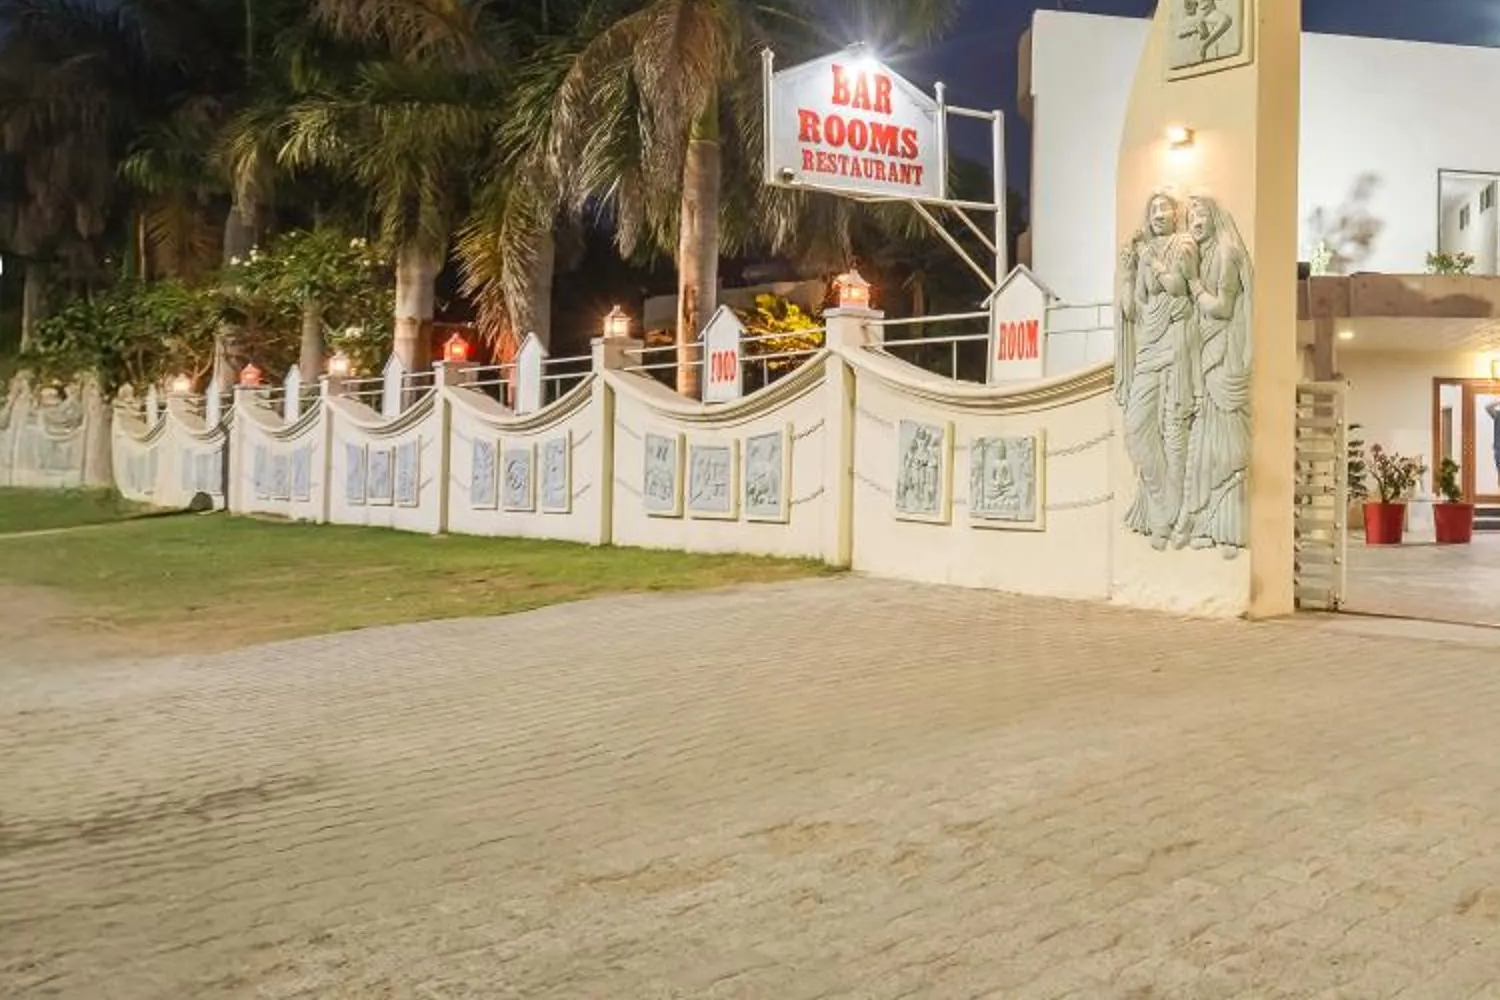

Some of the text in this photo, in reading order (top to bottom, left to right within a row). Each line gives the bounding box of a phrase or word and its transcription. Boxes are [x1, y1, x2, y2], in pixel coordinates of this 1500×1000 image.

[831, 63, 892, 115] BAR
[798, 108, 918, 160] ROOMS
[801, 148, 923, 186] RESTAURANT
[998, 319, 1038, 361] ROOM
